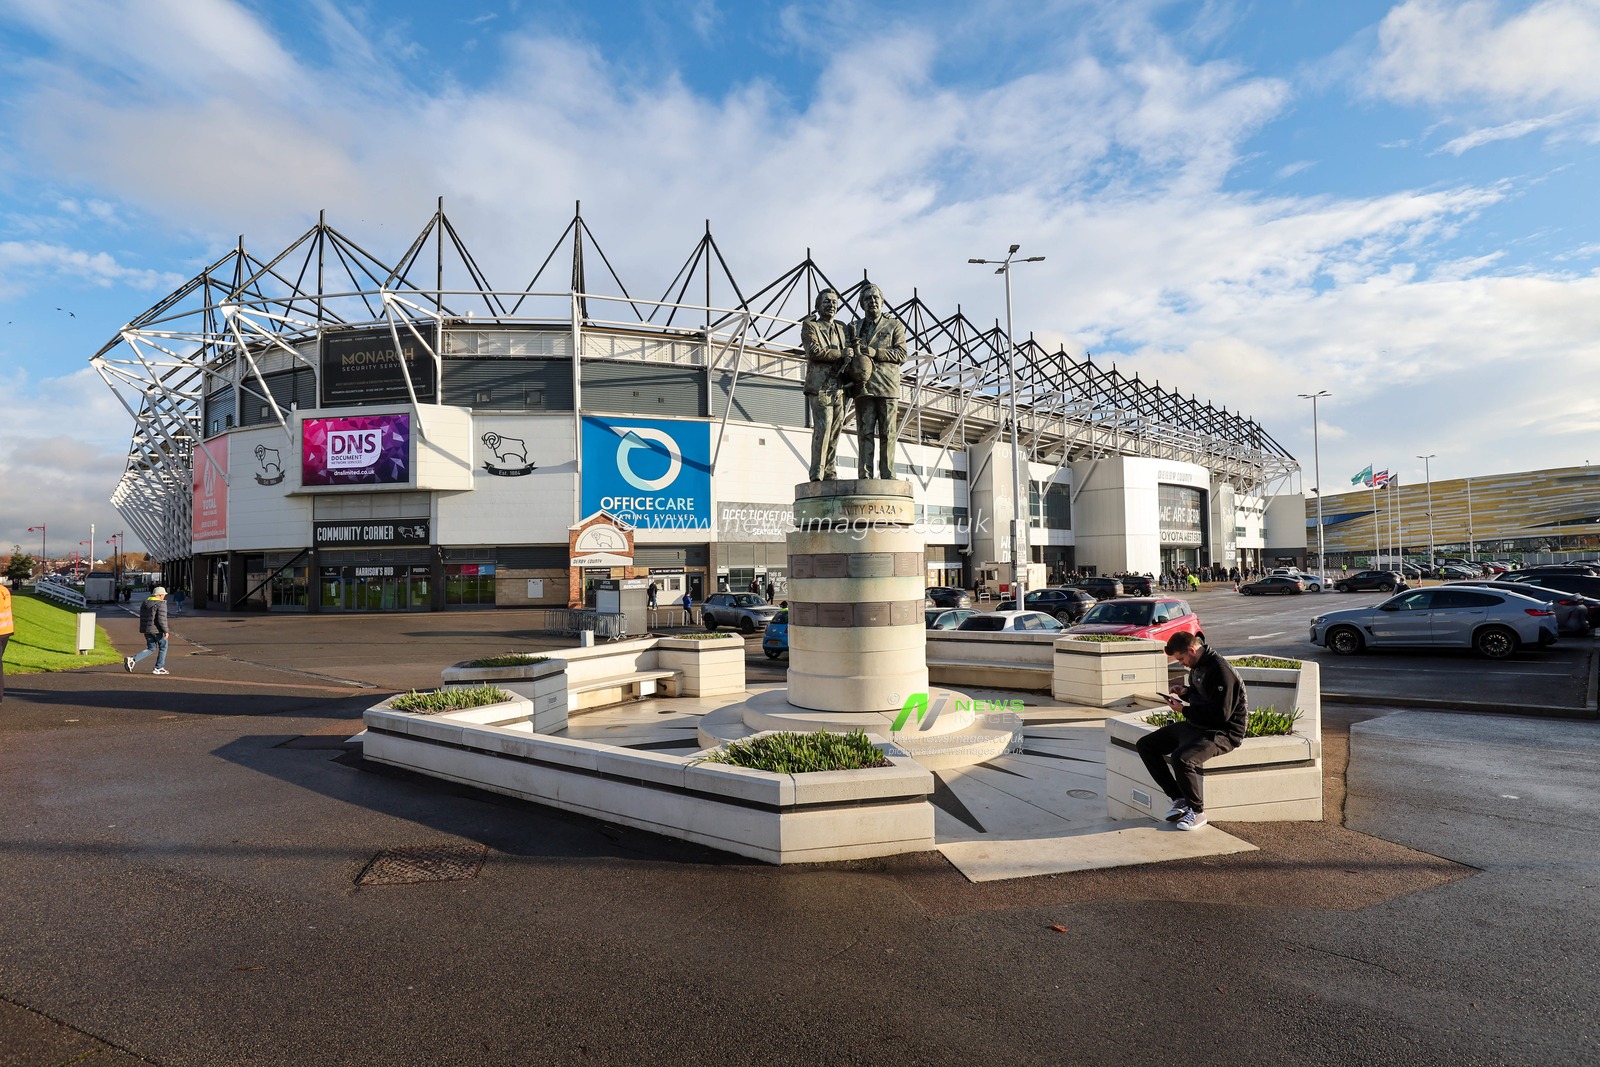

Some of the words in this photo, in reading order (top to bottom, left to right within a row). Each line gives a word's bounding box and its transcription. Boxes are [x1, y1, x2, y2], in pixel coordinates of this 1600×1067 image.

[341, 364, 377, 372] SECURITY
[332, 433, 376, 455] DNS
[722, 509, 747, 520] DCFC
[748, 509, 780, 521] TICKET
[868, 505, 896, 514] PLAZA
[317, 526, 361, 541] COMMUNITY
[363, 525, 394, 540] CORNER
